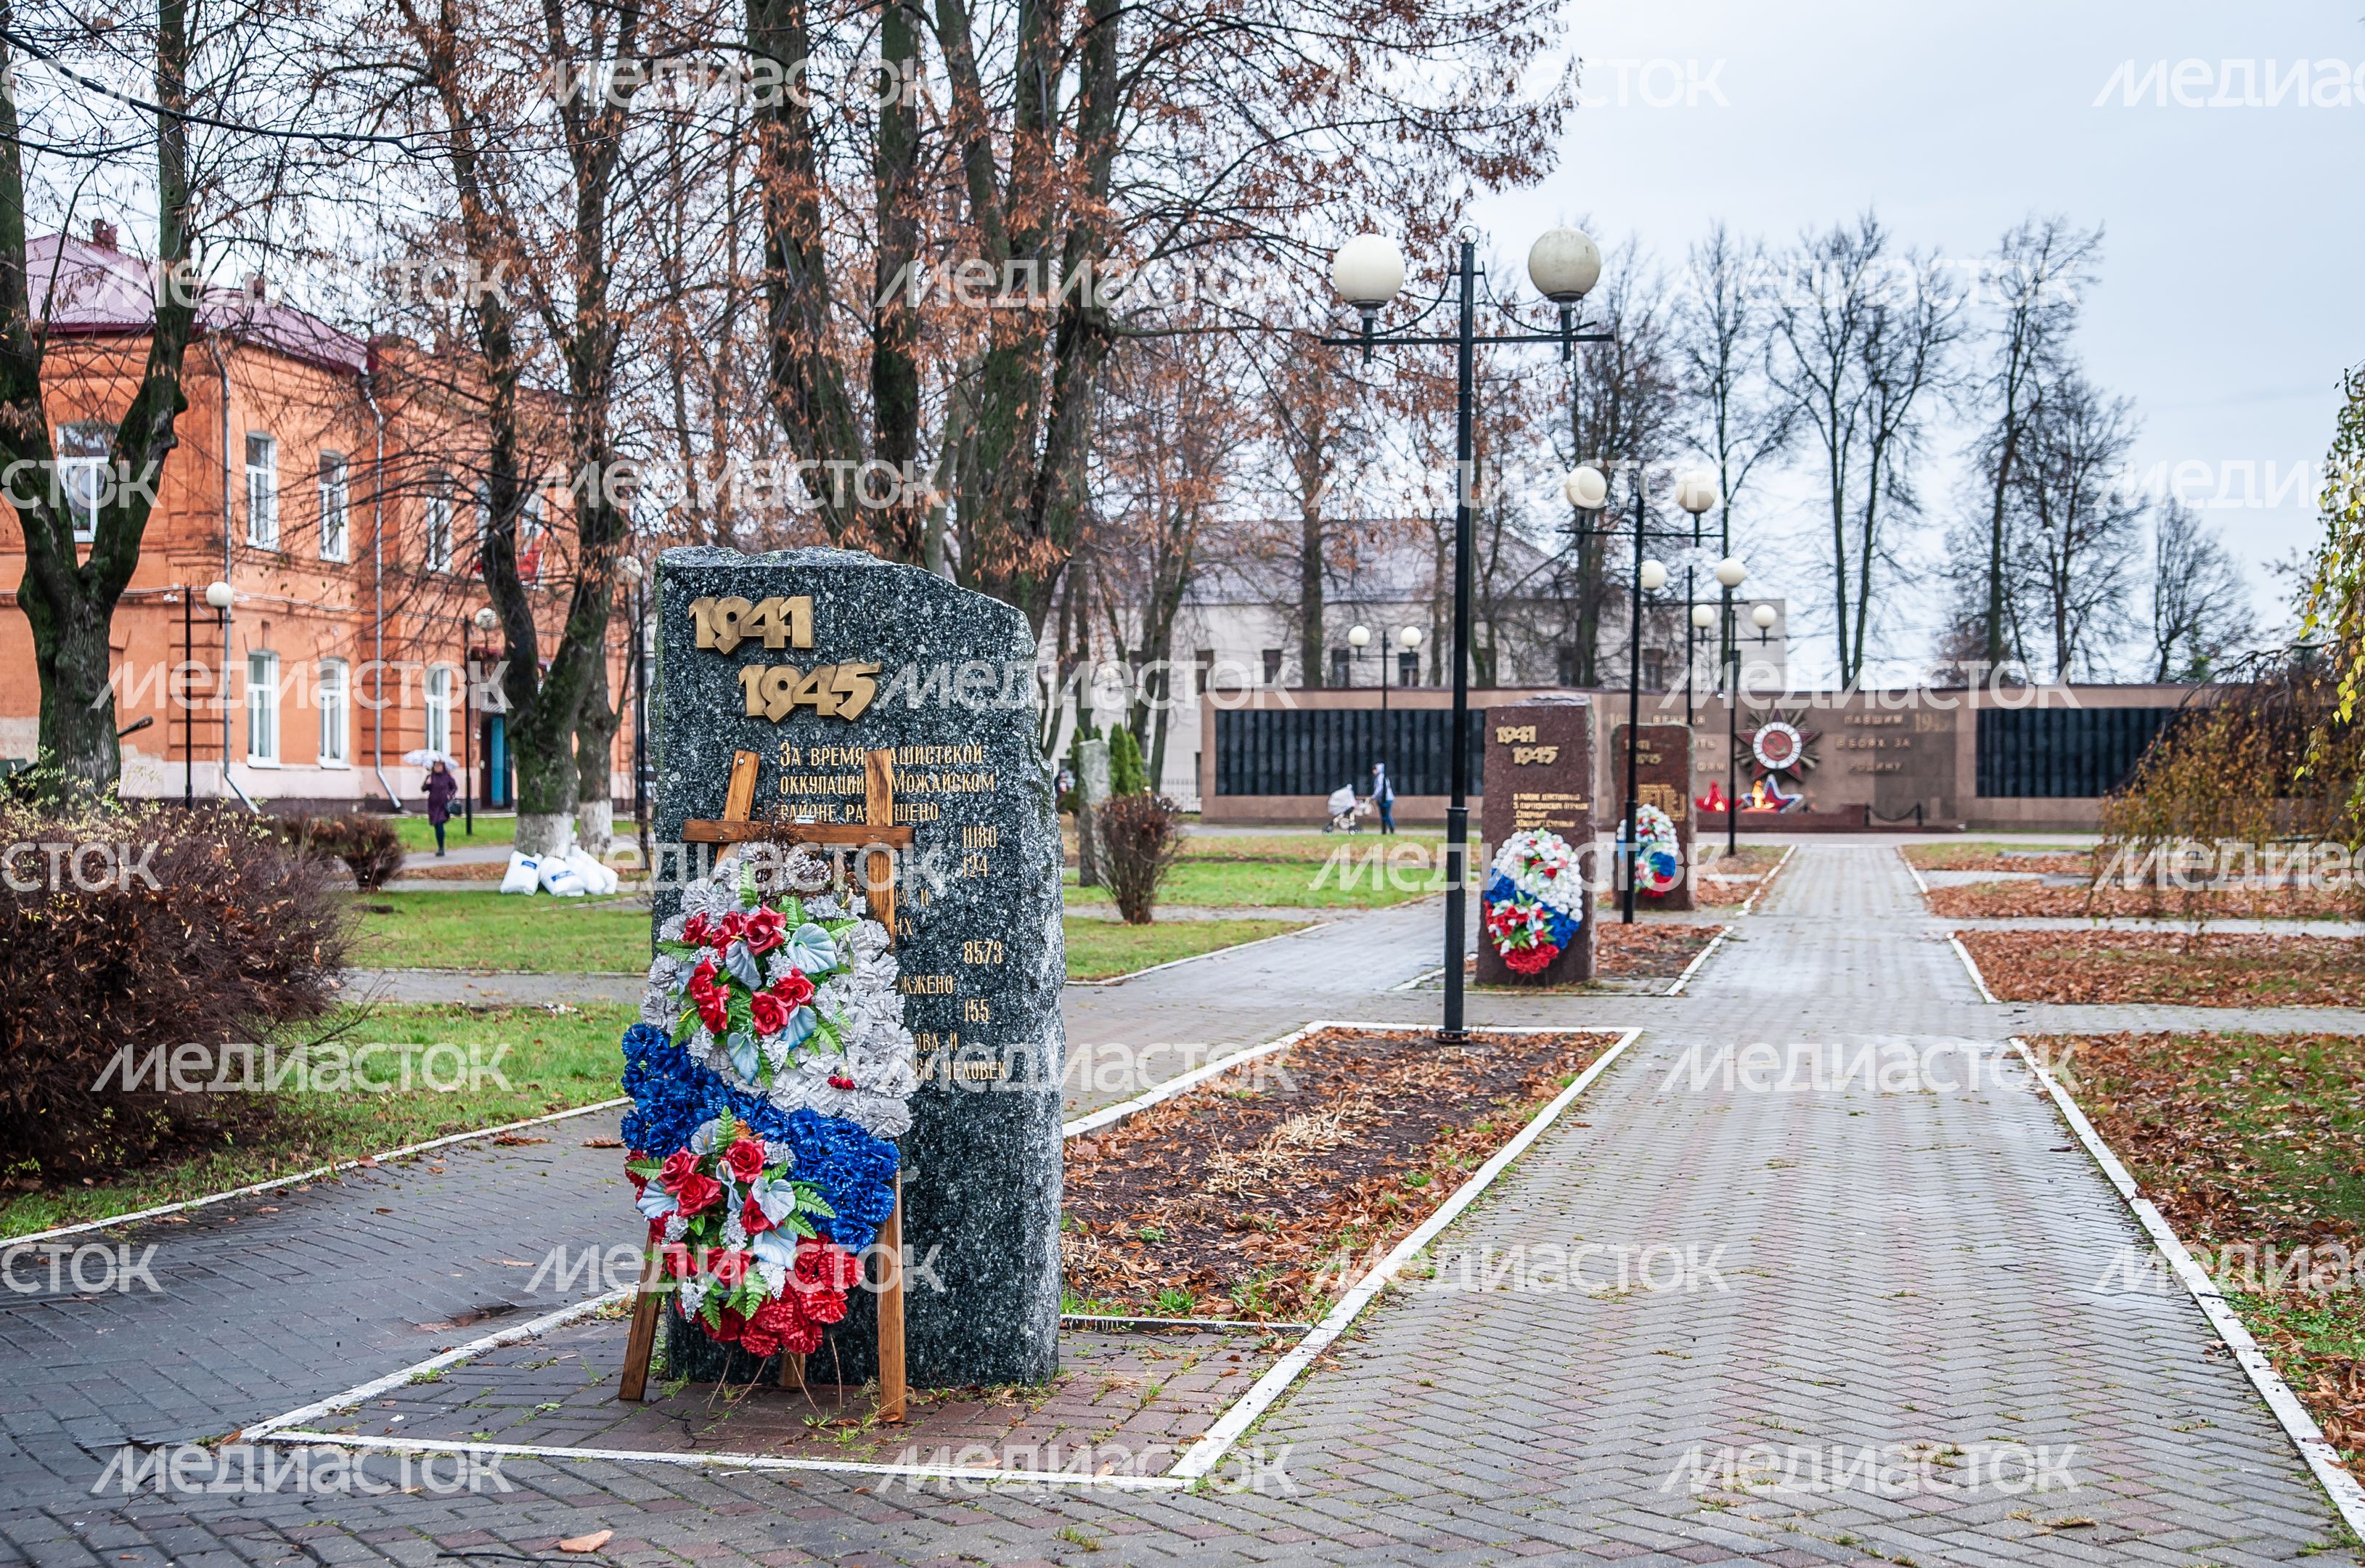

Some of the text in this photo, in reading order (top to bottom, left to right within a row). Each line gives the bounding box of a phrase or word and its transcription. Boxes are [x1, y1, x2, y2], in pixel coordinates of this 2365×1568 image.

[689, 596, 814, 654] 1941
[738, 662, 883, 723] 1945
[1496, 725, 1536, 745] 1941
[811, 746, 865, 767] ВРЕМЯ
[891, 741, 983, 764] АШИСТСКОЙ
[1512, 746, 1559, 765] 1945
[780, 775, 865, 796] ОККУПАЦИИ
[846, 803, 939, 822] РАШЕНО
[963, 854, 988, 878] 124
[964, 941, 1003, 964] 8573
[900, 974, 953, 995] ЖЖЕНО
[965, 998, 989, 1022] 155
[944, 1060, 1008, 1080] ЧЕЛОВЕК
